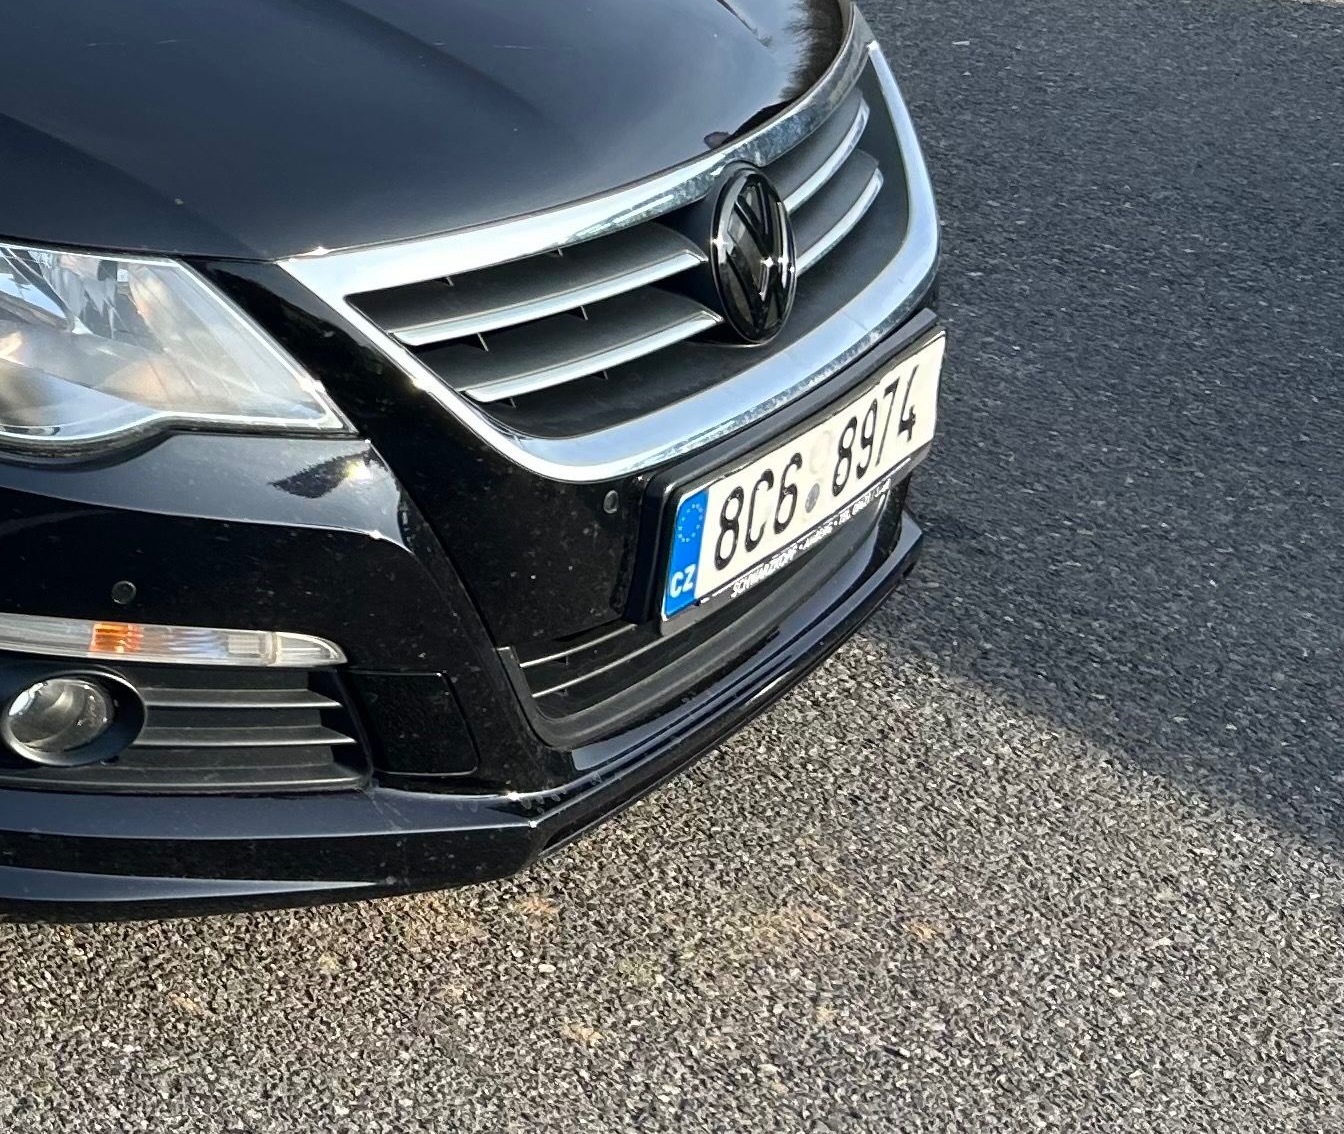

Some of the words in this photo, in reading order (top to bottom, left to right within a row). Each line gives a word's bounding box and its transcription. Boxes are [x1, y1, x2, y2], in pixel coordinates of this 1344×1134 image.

[714, 453, 802, 570] 8C6
[832, 365, 920, 496] 8974
[670, 564, 696, 598] CZ
